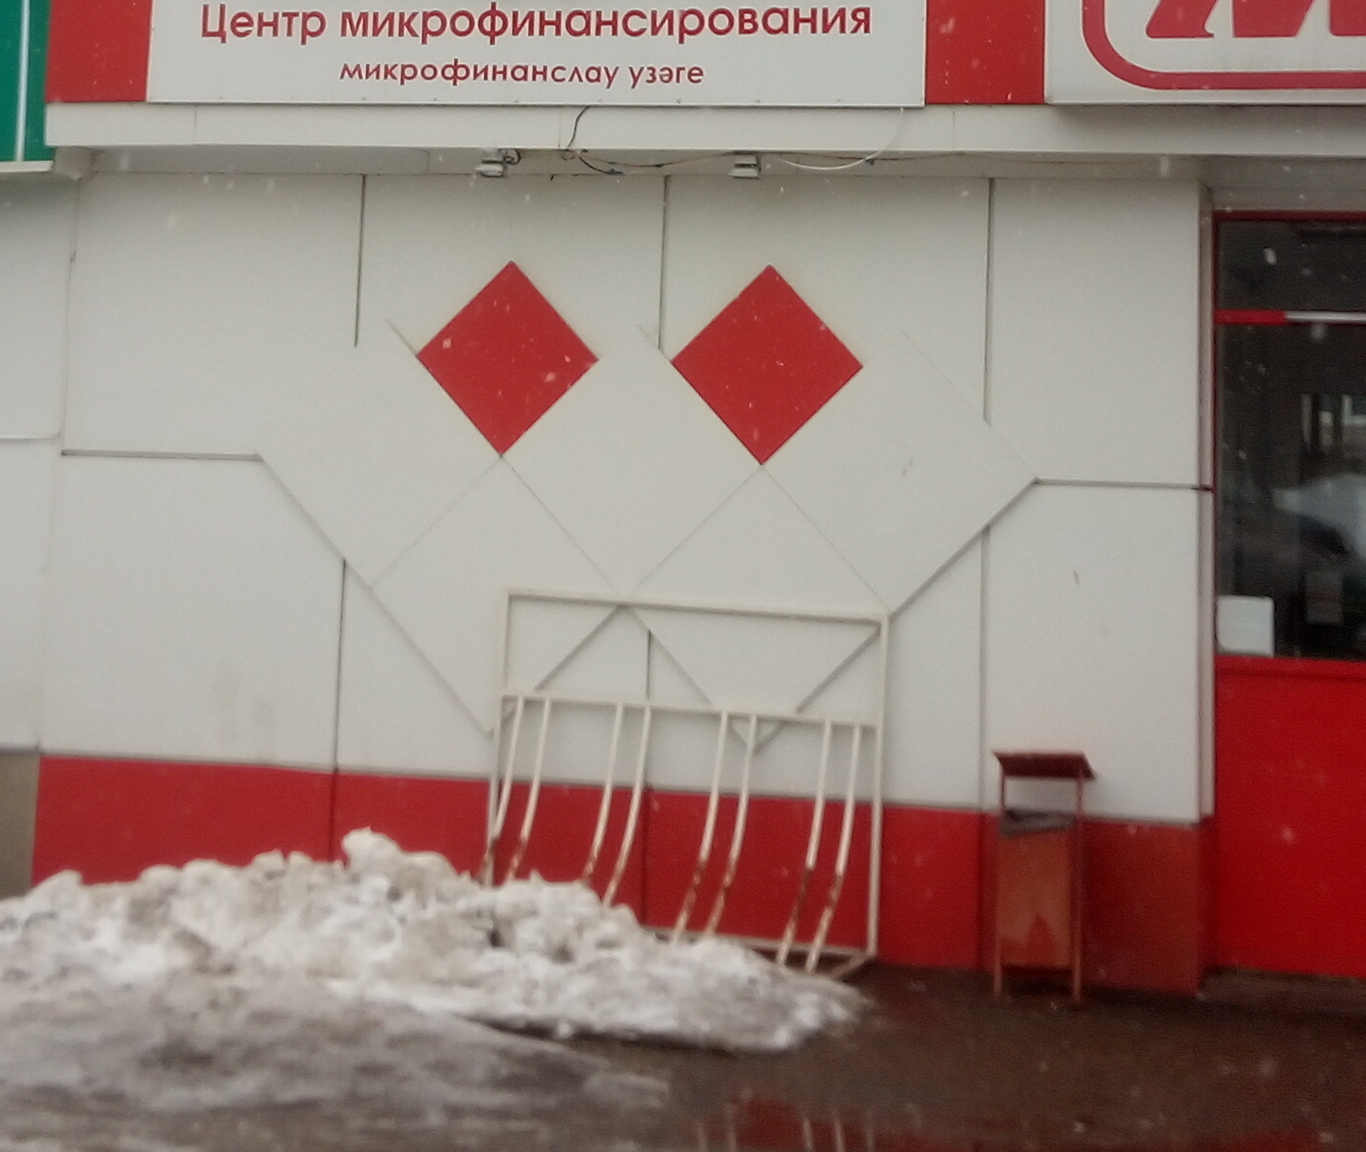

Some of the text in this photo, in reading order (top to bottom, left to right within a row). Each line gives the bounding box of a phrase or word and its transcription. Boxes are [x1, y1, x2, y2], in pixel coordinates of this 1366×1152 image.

[200, 1, 873, 46] Центр микрофинансирования
[339, 58, 705, 90] микрофинанслау узәге
